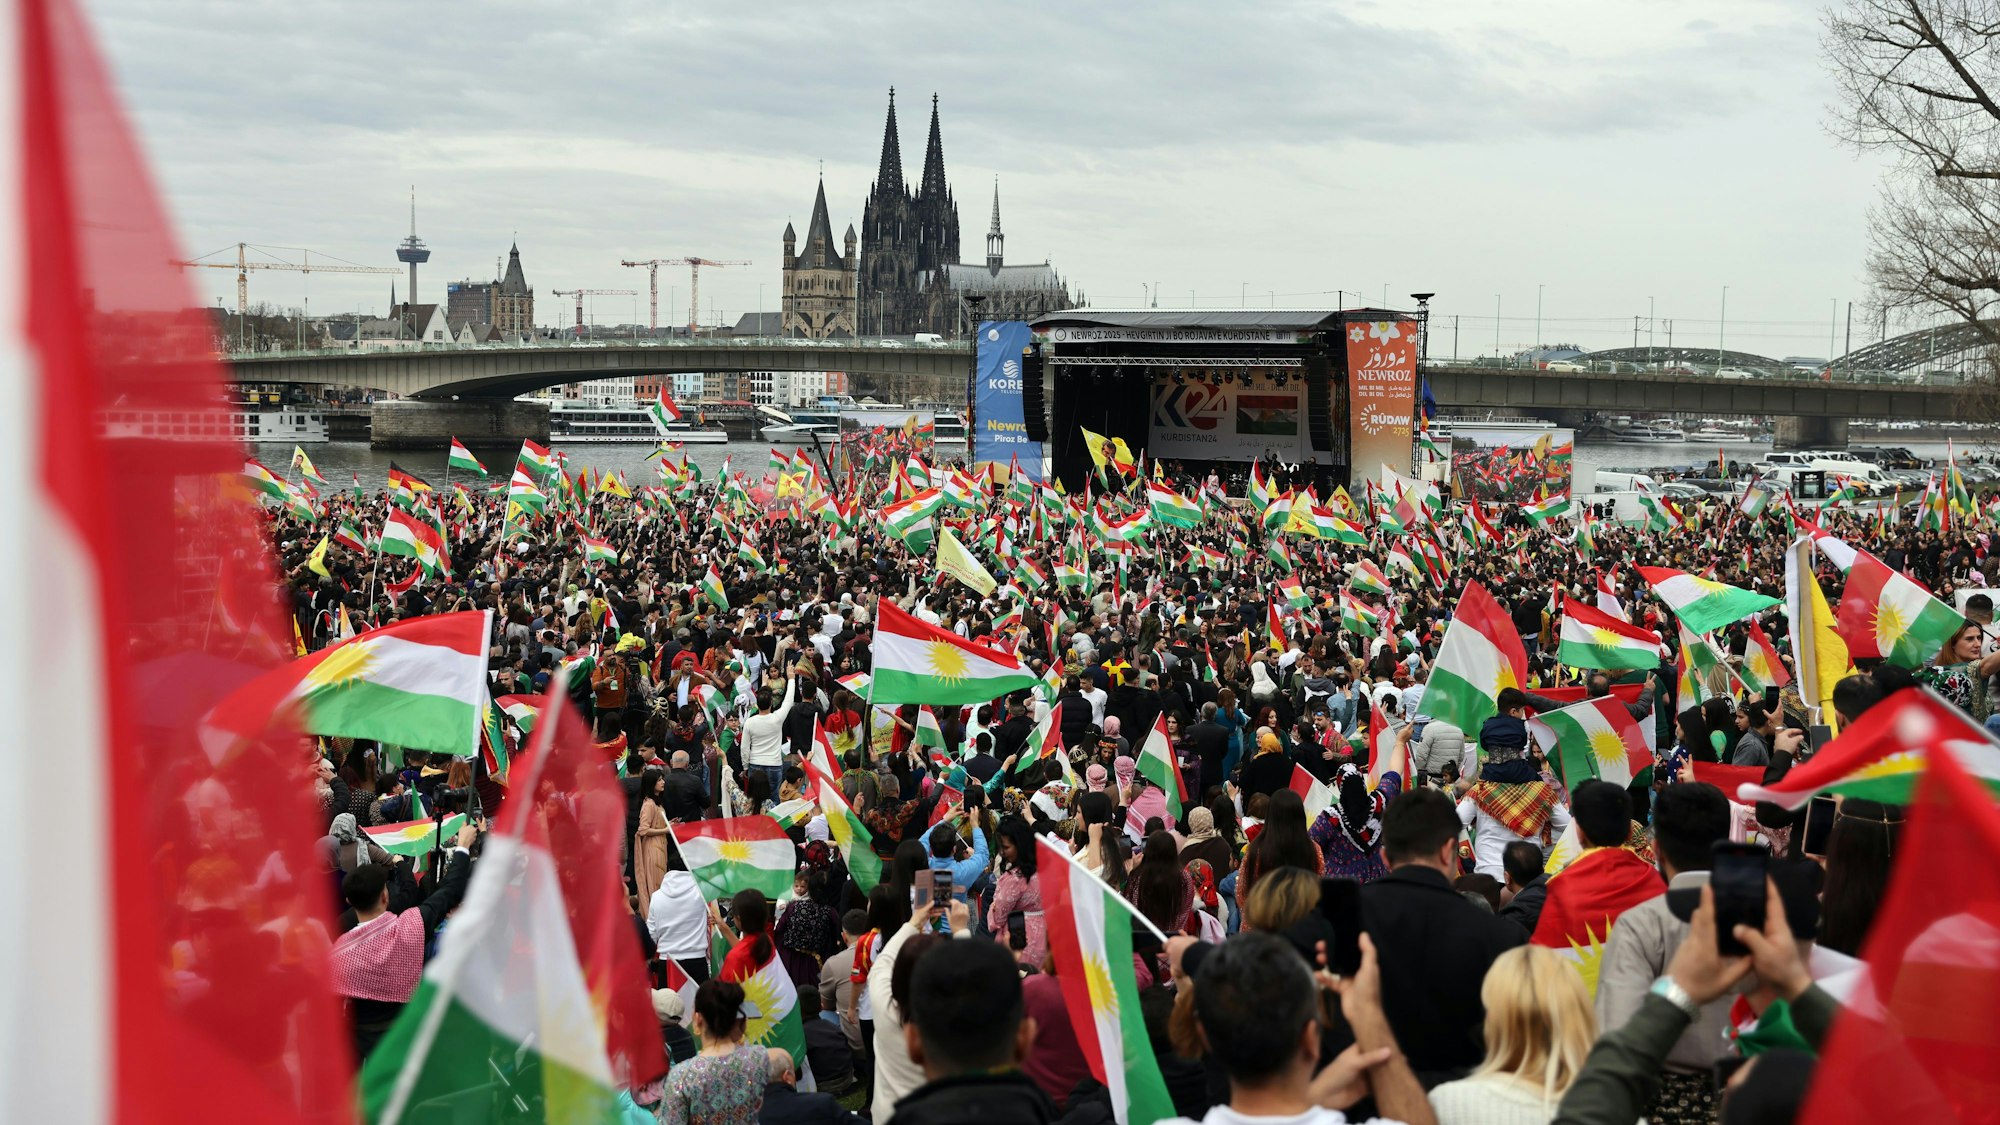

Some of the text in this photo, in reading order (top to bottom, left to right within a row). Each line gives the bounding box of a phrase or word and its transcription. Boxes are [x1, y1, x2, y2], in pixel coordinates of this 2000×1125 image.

[1071, 331, 1102, 340] NEWROZ
[1103, 330, 1121, 339] 2025
[1126, 331, 1164, 340] HEVGIRTIN
[1165, 331, 1172, 340] JI
[1173, 331, 1183, 340] BO
[1357, 369, 1411, 381] NEWROZ
[1370, 412, 1410, 425] RÛDAW
[1393, 426, 1410, 437] 2725
[1017, 435, 1028, 443] Be
[1160, 433, 1217, 443] KURDISTAN24
